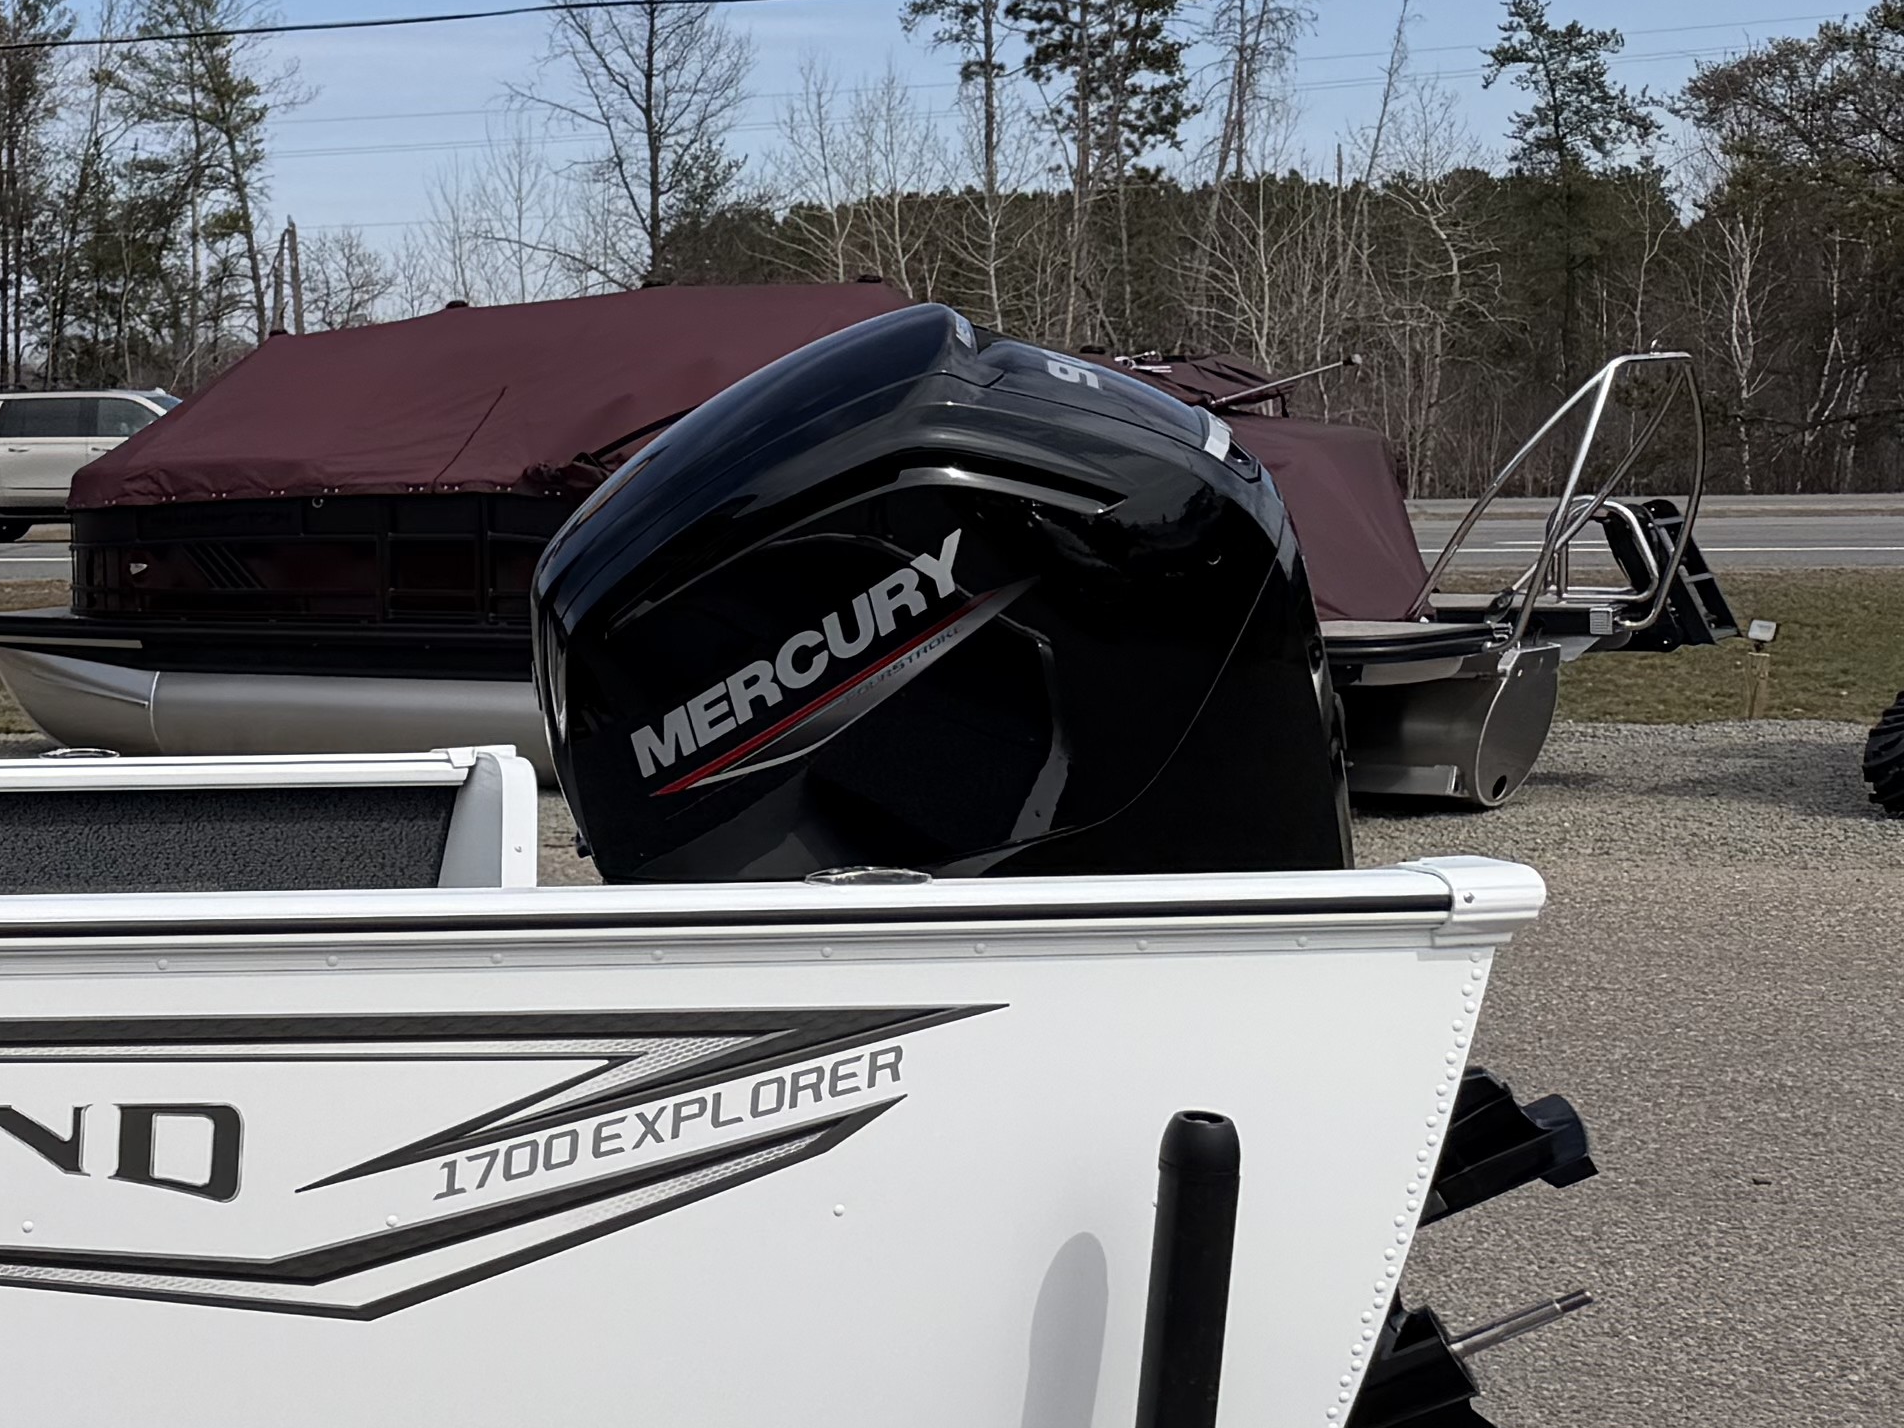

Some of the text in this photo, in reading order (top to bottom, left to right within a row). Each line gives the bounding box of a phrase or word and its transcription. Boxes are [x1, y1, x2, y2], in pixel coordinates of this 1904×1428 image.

[630, 528, 962, 778] MERCURY
[845, 625, 963, 705] FOURSTROKE
[433, 1045, 904, 1200] 1700 EXPLORER
